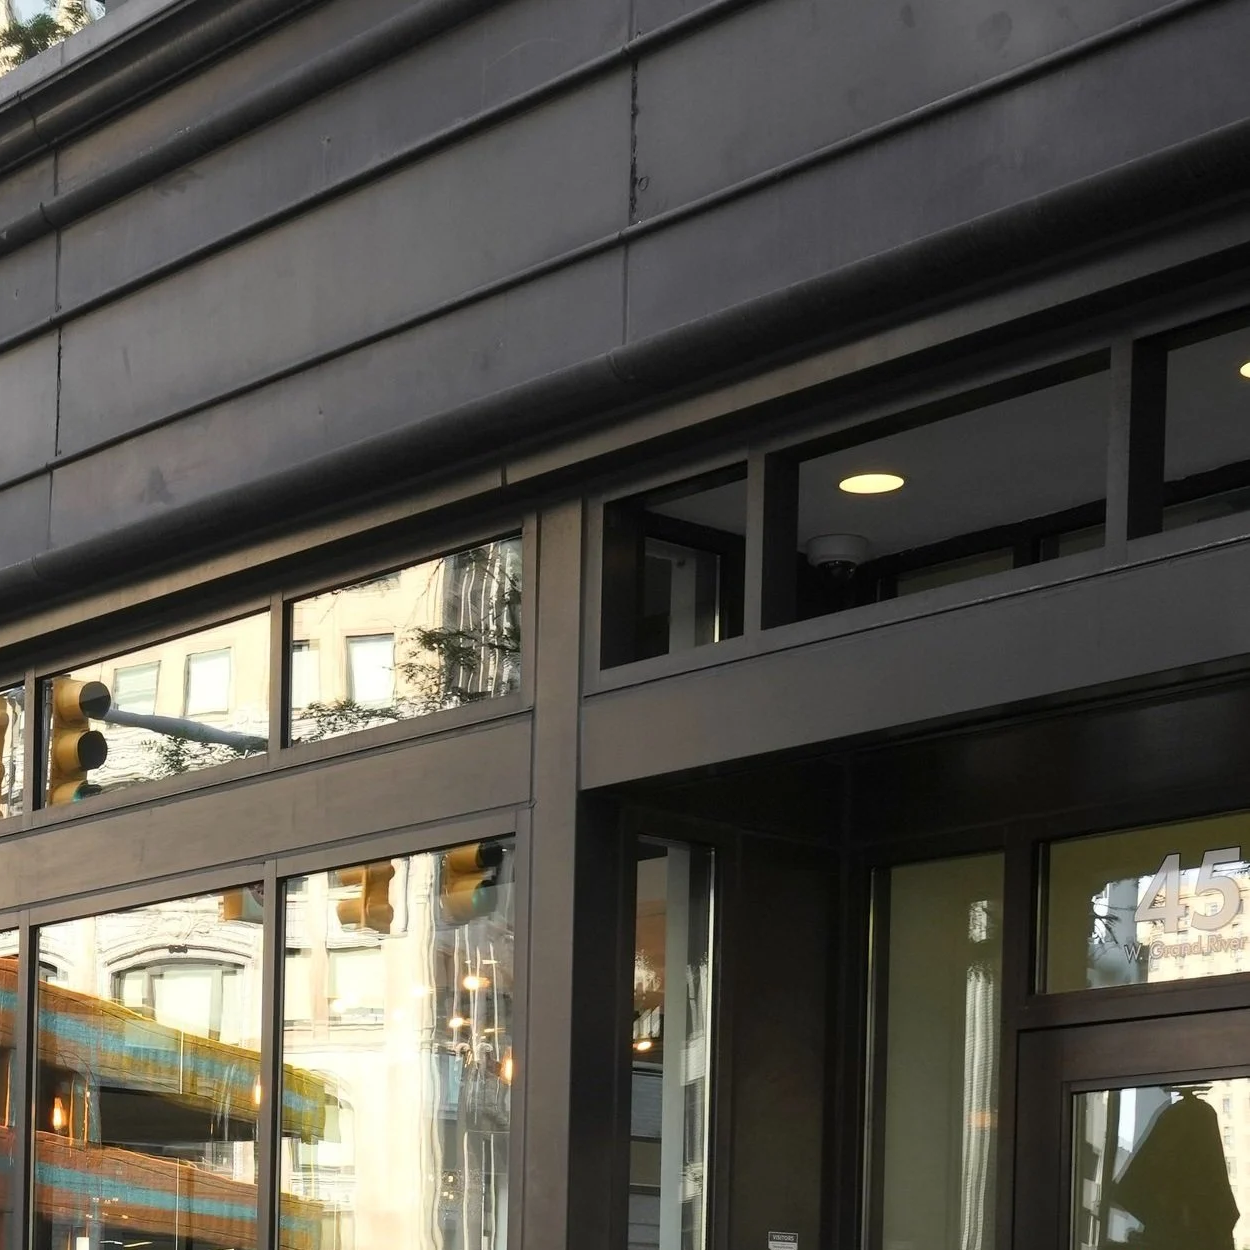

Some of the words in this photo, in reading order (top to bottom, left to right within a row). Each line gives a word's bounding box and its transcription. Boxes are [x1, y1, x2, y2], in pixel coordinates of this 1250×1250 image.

[1134, 846, 1241, 934] 45
[1124, 943, 1143, 964] W.
[1150, 935, 1202, 960] Grand
[1207, 934, 1249, 955] River
